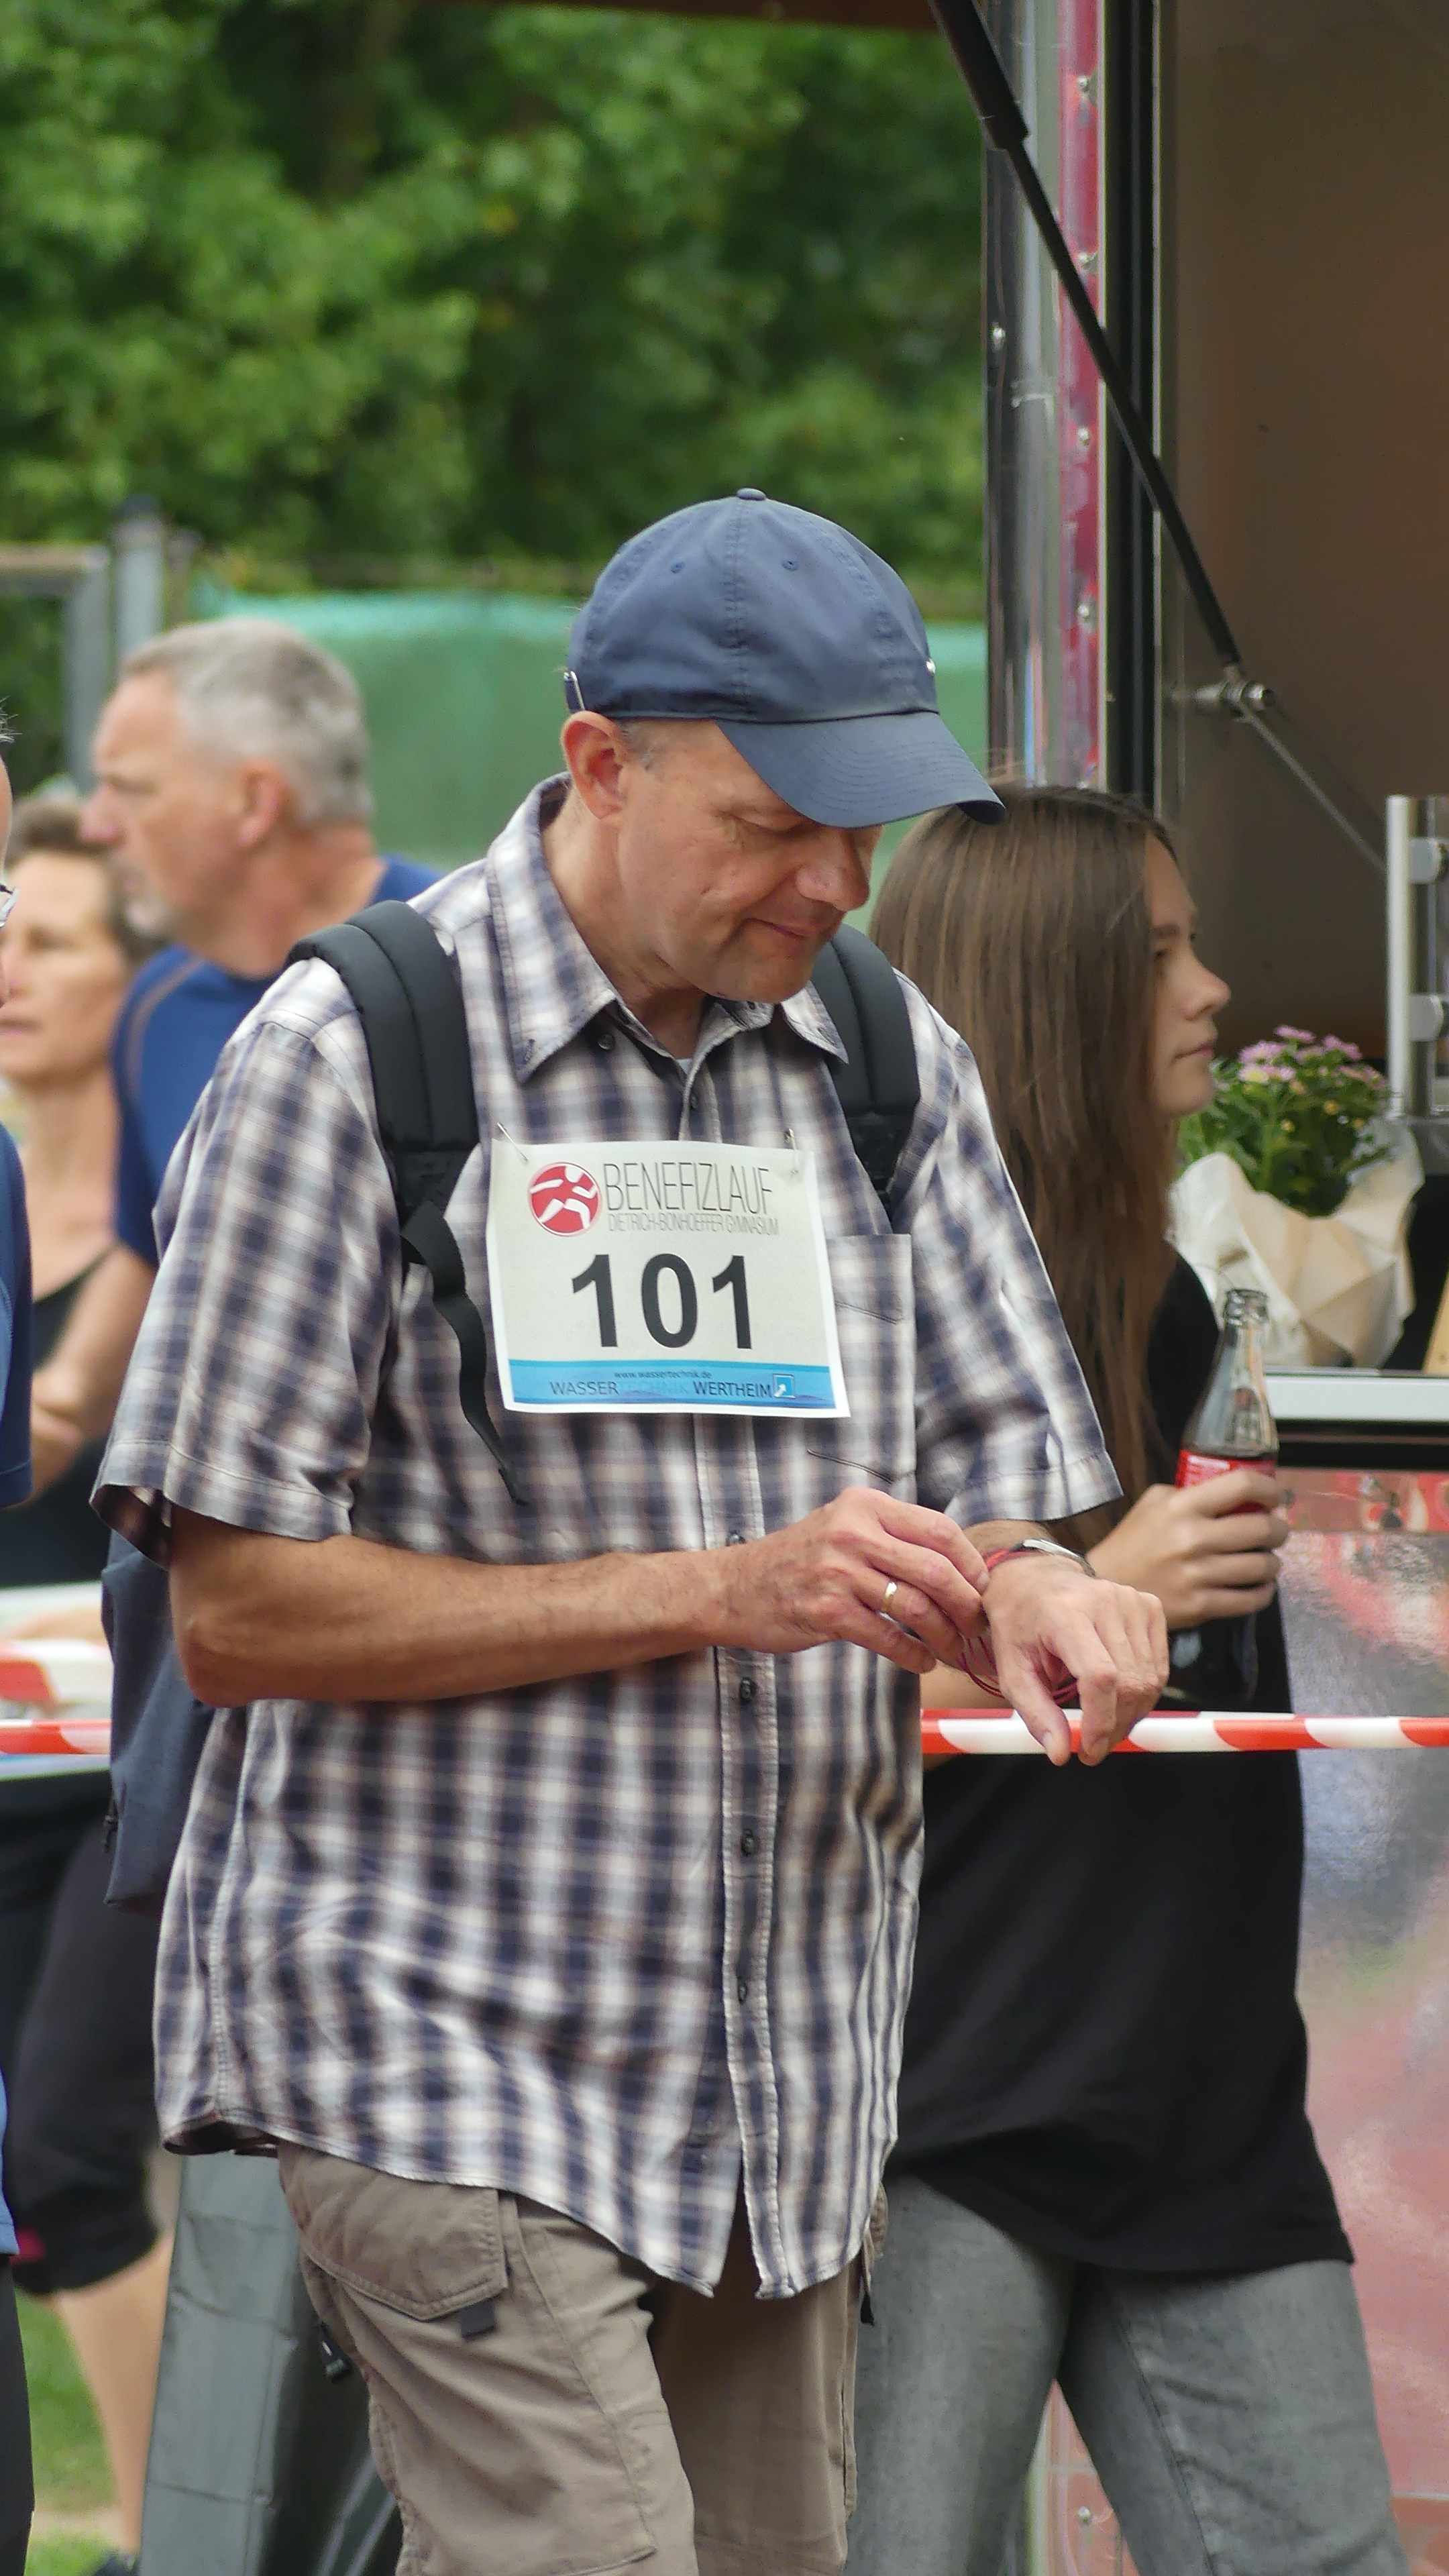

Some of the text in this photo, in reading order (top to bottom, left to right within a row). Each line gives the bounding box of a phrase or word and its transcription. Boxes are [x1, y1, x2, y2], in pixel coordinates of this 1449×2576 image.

[603, 1163, 773, 1215] BENEFIZLAUF
[572, 1253, 752, 1350] 101
[549, 1381, 620, 1396] WASSER
[692, 1381, 773, 1398] WERTHEIM
